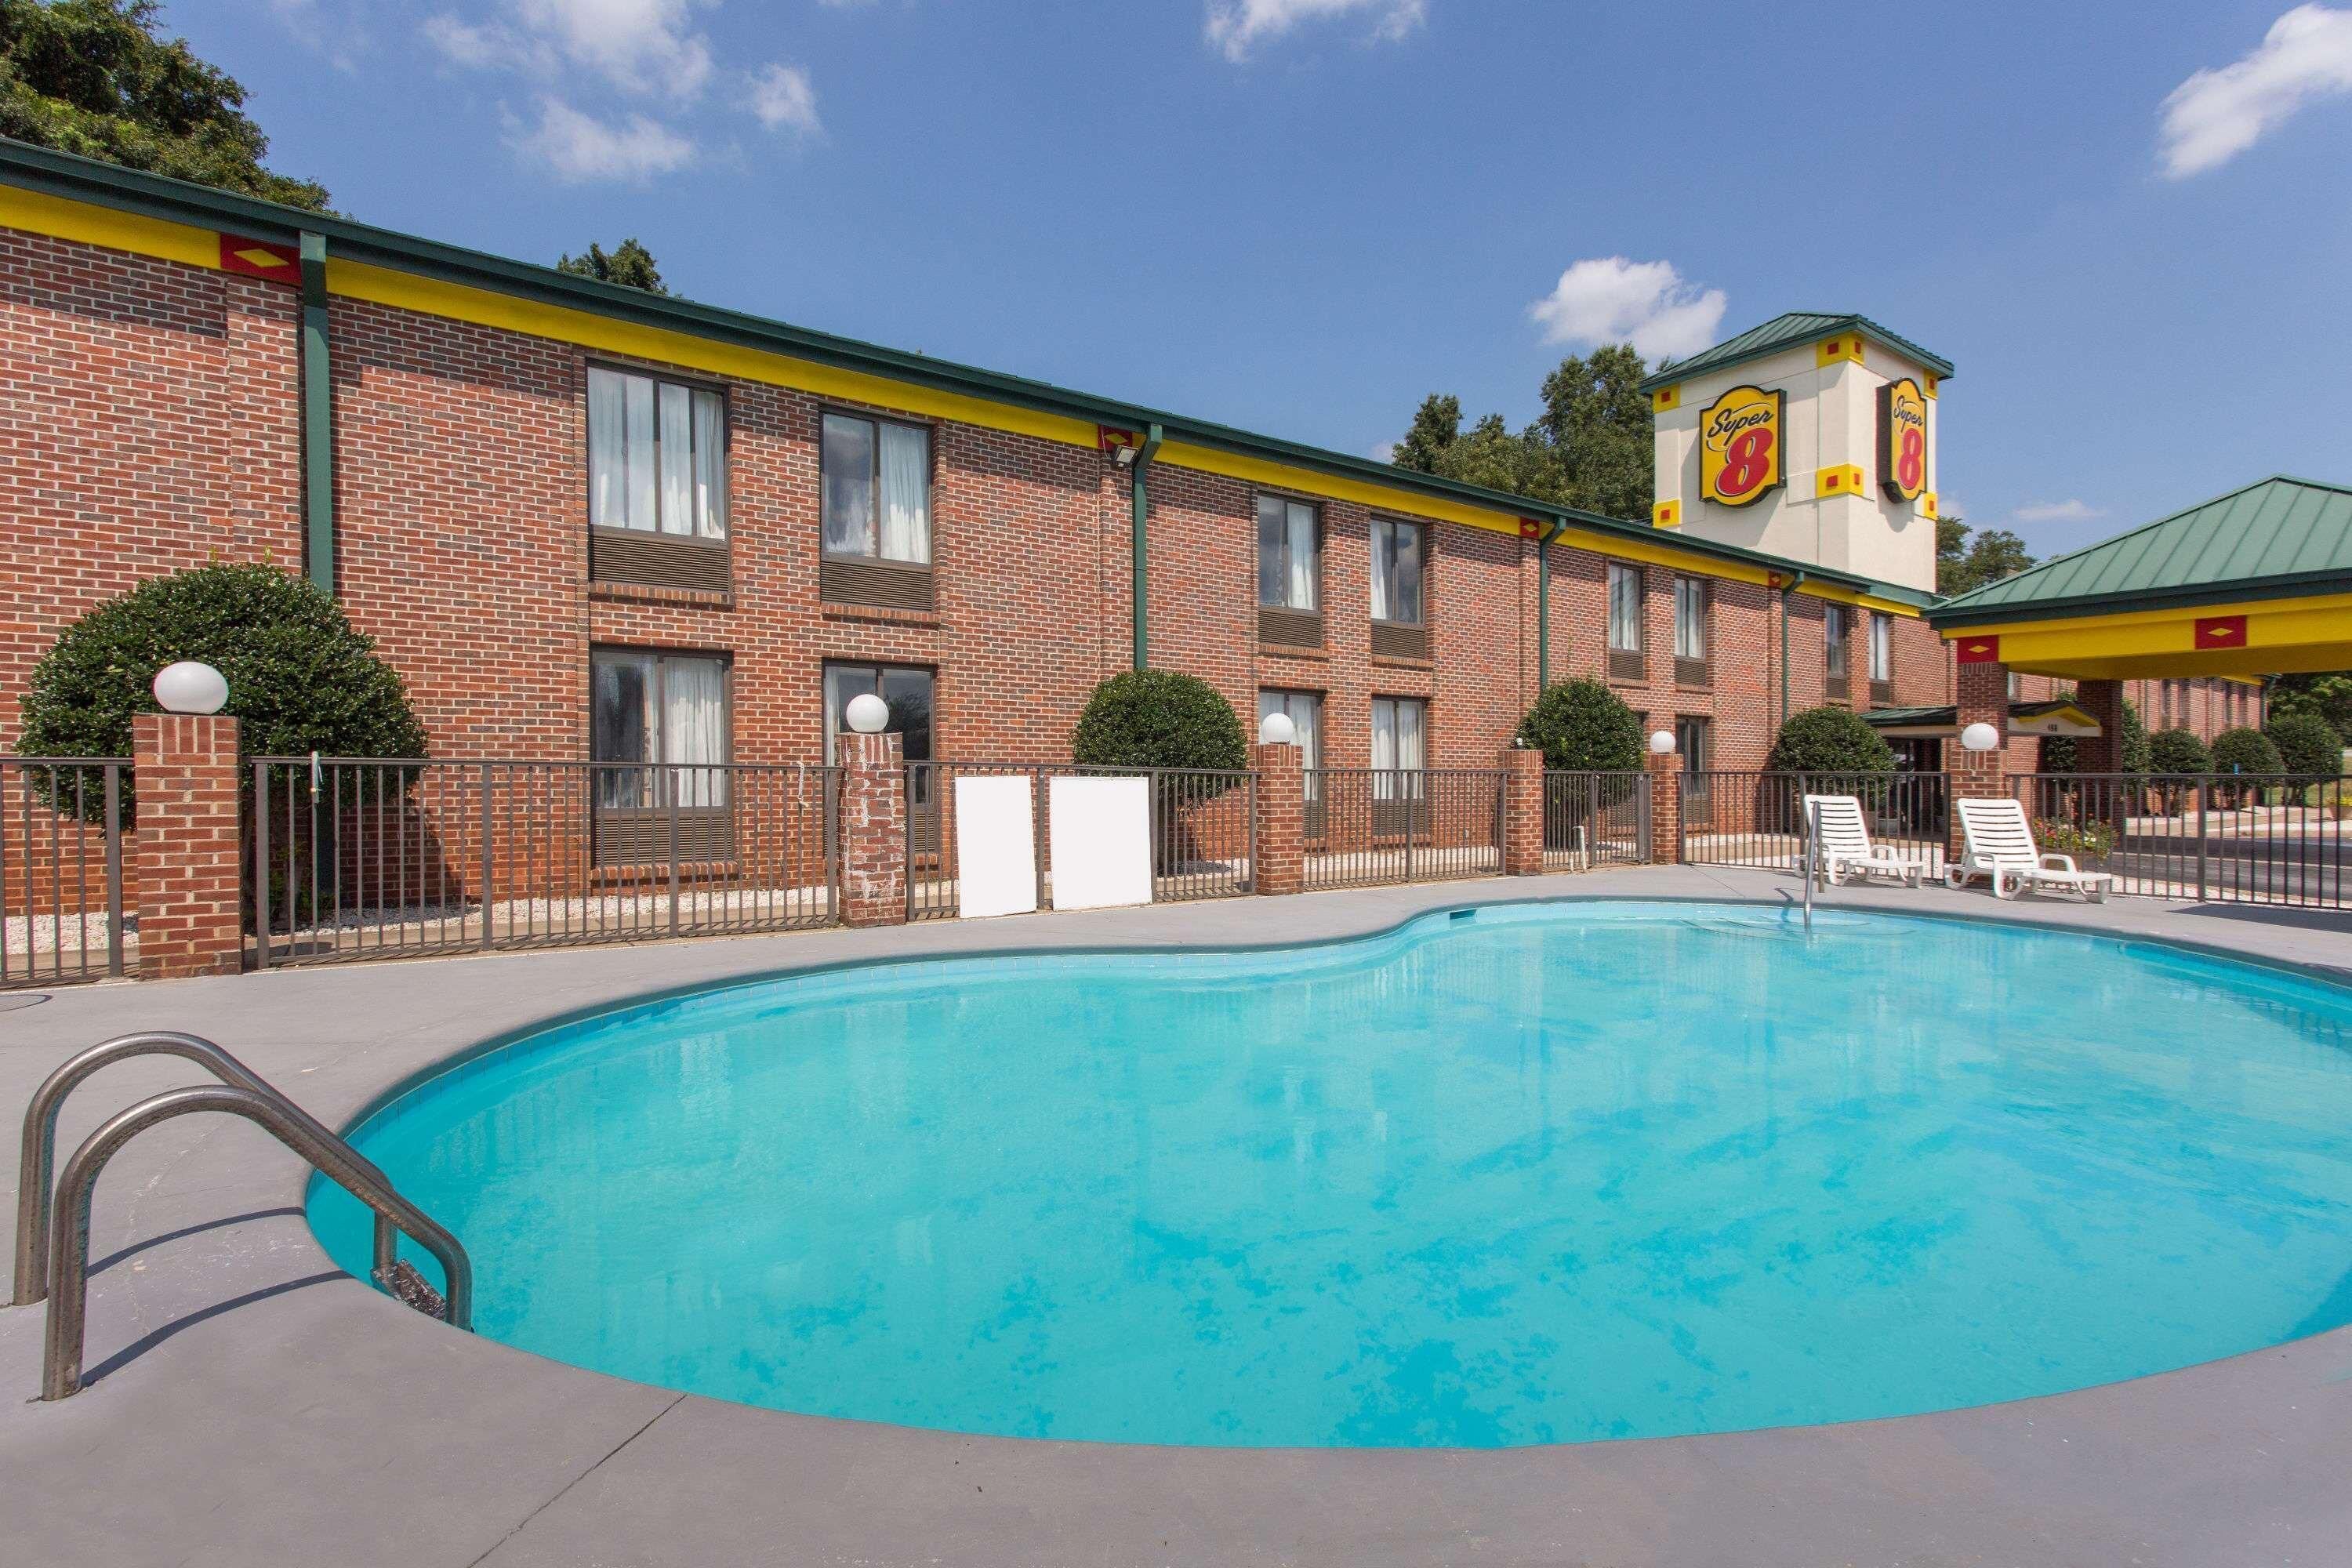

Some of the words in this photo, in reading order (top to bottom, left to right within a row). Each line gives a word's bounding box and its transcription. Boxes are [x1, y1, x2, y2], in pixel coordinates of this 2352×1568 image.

[1707, 408, 1773, 446] Super
[1894, 394, 1923, 433] Super
[1715, 427, 1773, 497] 8
[1897, 428, 1922, 490] 8
